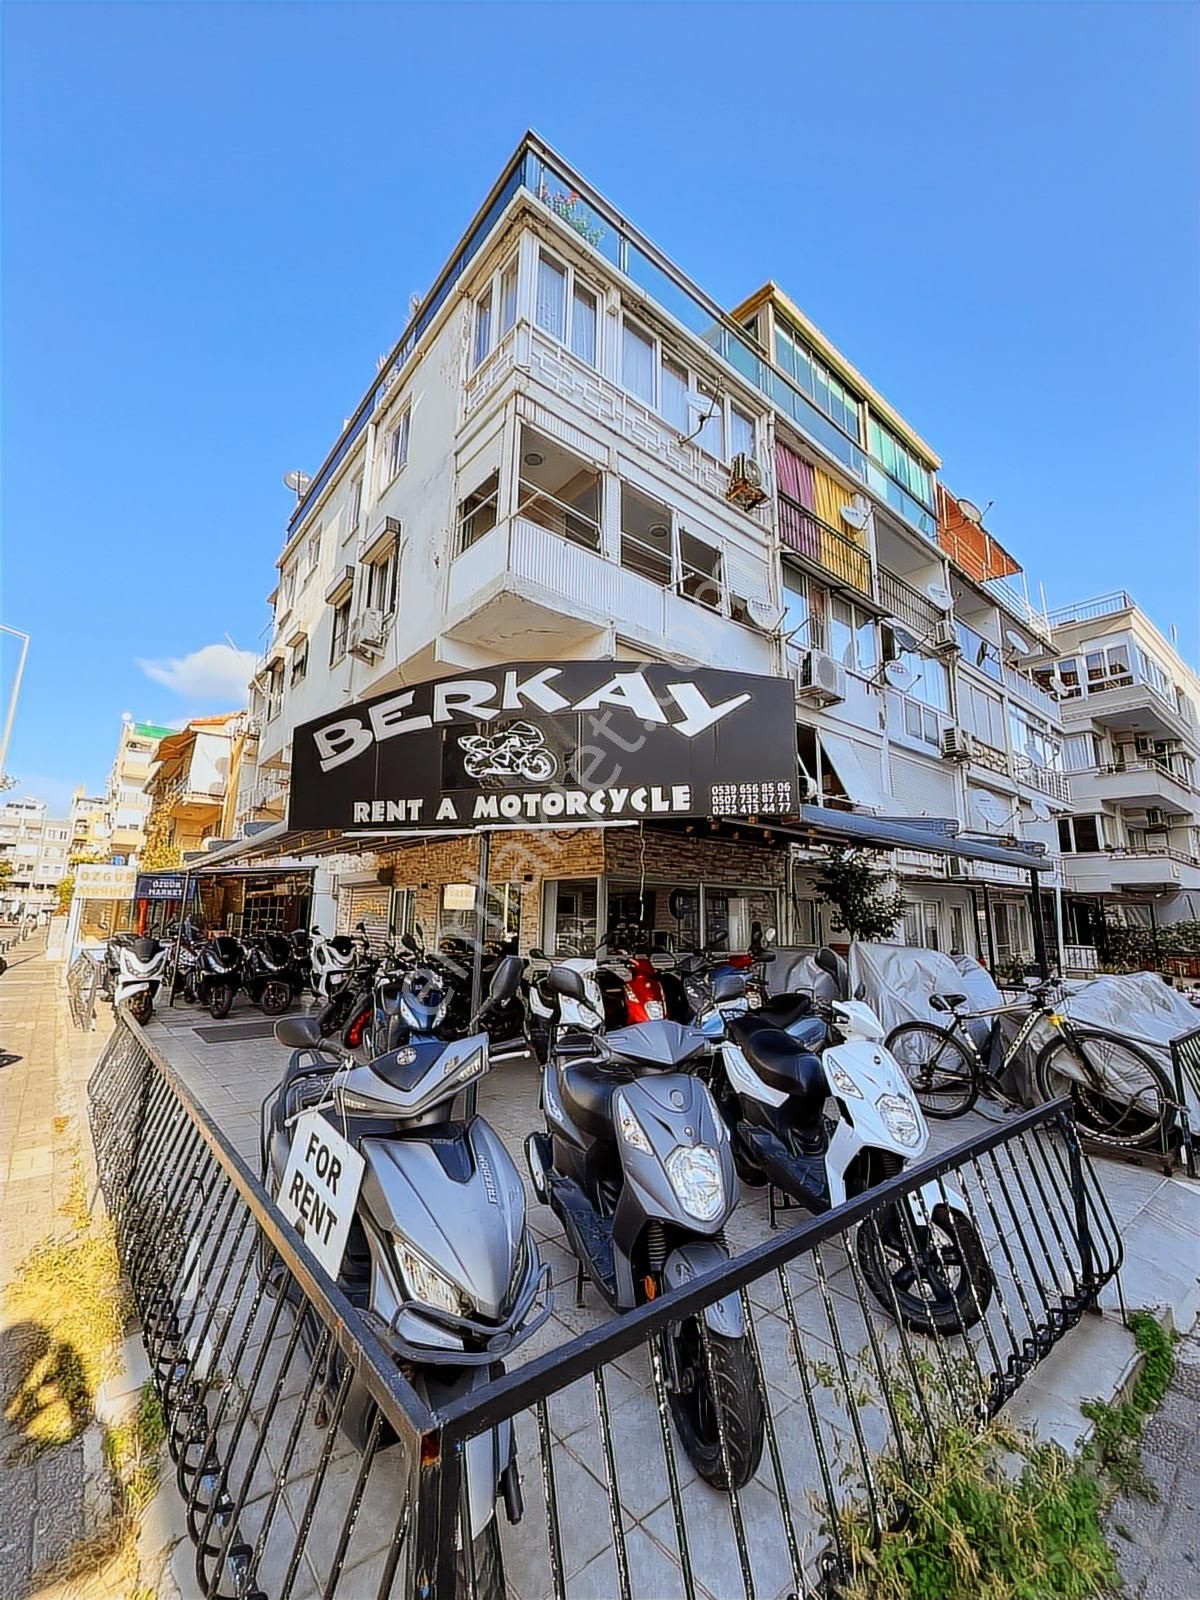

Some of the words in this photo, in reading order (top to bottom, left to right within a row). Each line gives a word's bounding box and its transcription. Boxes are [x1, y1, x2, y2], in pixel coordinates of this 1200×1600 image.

[313, 667, 752, 772] BERKAY
[353, 799, 423, 823] RENT
[435, 797, 458, 820] A
[472, 785, 691, 819] MOTORCYCLE
[711, 785, 737, 795] 0539
[740, 783, 759, 794] 656
[777, 781, 791, 792] 06
[712, 795, 737, 805] 0507
[740, 794, 760, 804] 732
[778, 792, 791, 802] 71
[712, 805, 738, 815] 0252
[740, 803, 760, 814] 413
[761, 803, 776, 813] 44
[778, 802, 791, 813] 77
[305, 1132, 342, 1196] FOR
[288, 1168, 337, 1246] RENT
